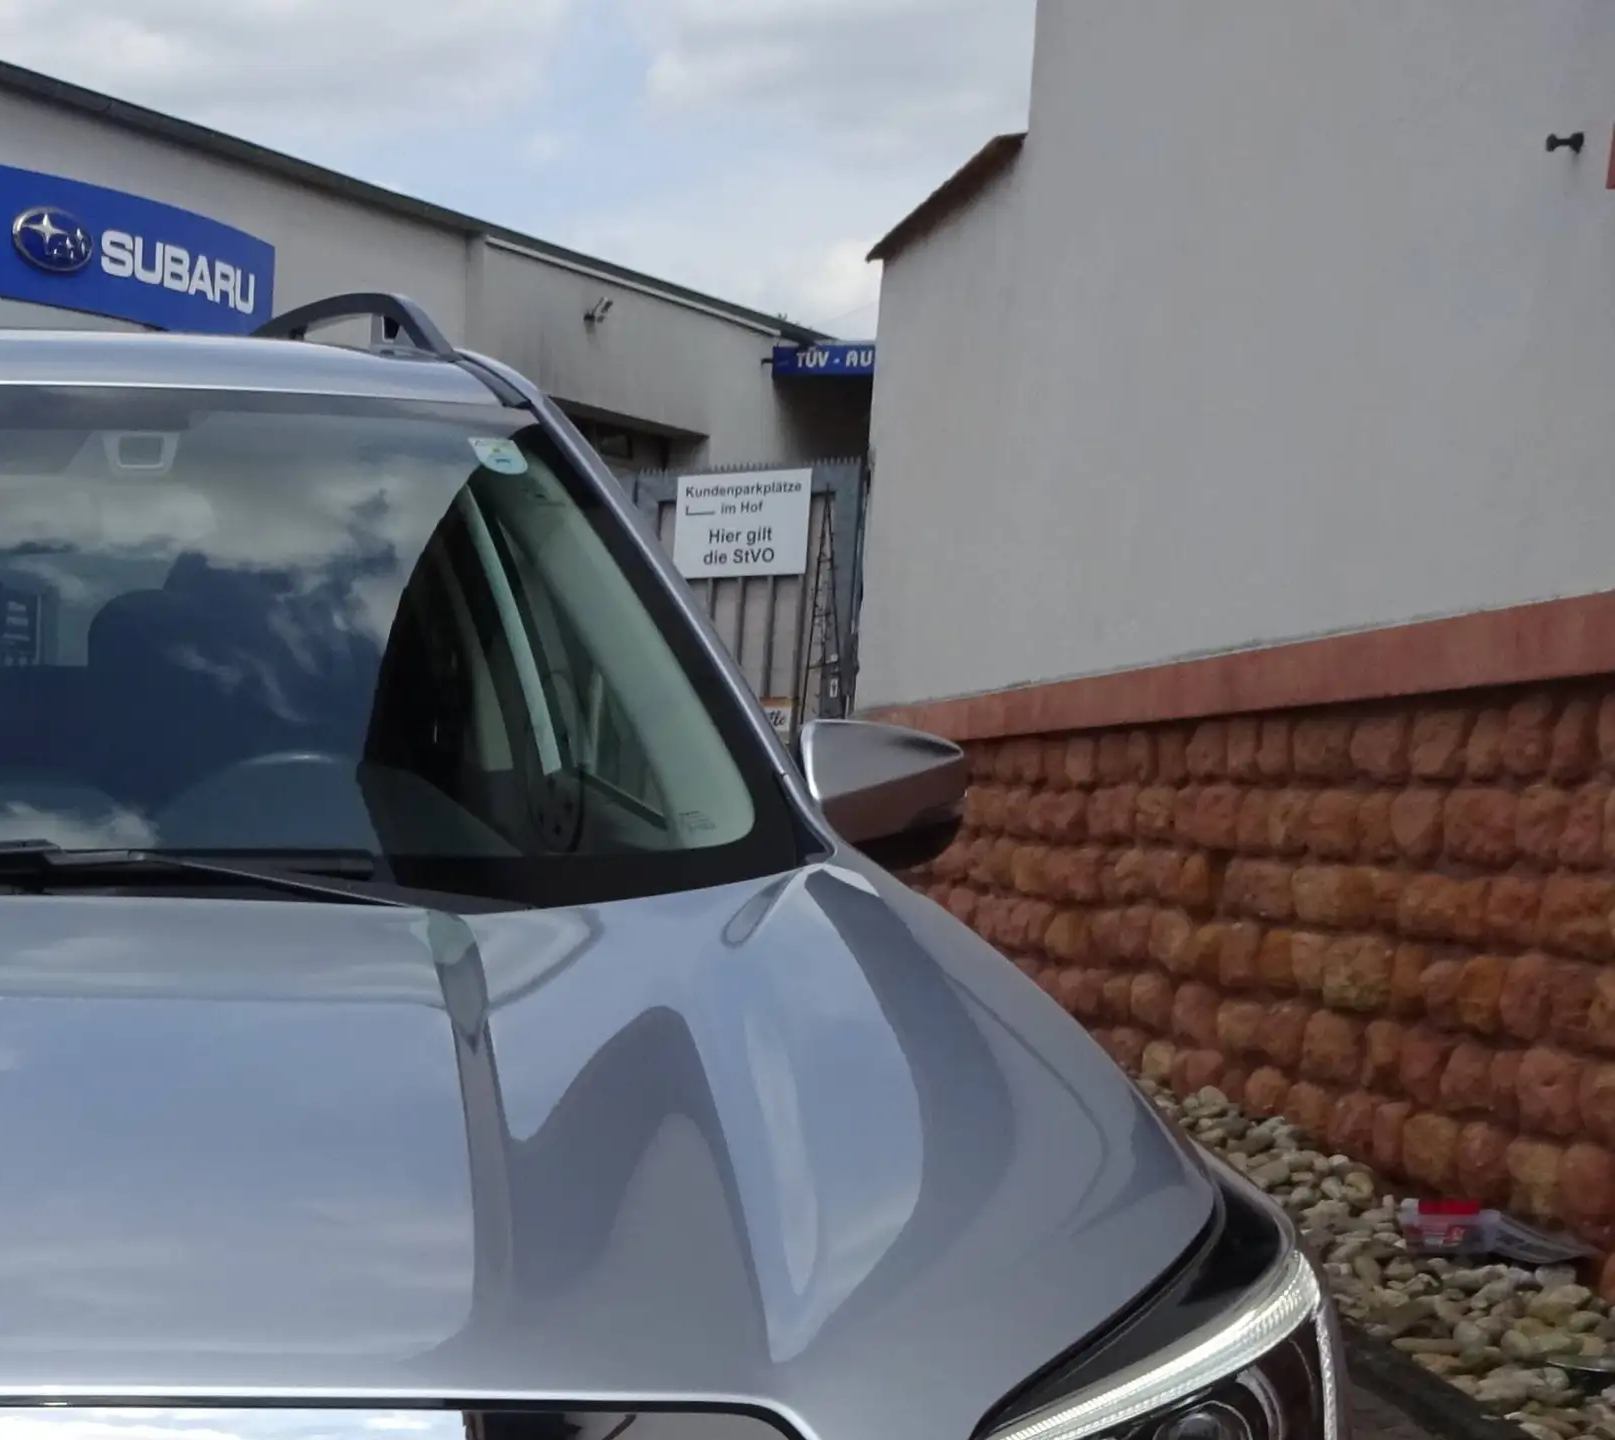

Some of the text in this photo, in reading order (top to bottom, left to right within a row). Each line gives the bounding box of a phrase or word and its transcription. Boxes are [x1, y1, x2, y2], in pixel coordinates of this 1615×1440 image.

[100, 229, 255, 315] SUBARU
[845, 349, 873, 368] AU
[685, 481, 802, 499] Kundenparkplätze
[720, 500, 763, 515] im Hof
[708, 526, 773, 546] Hier gilt
[703, 547, 775, 566] die StVO
